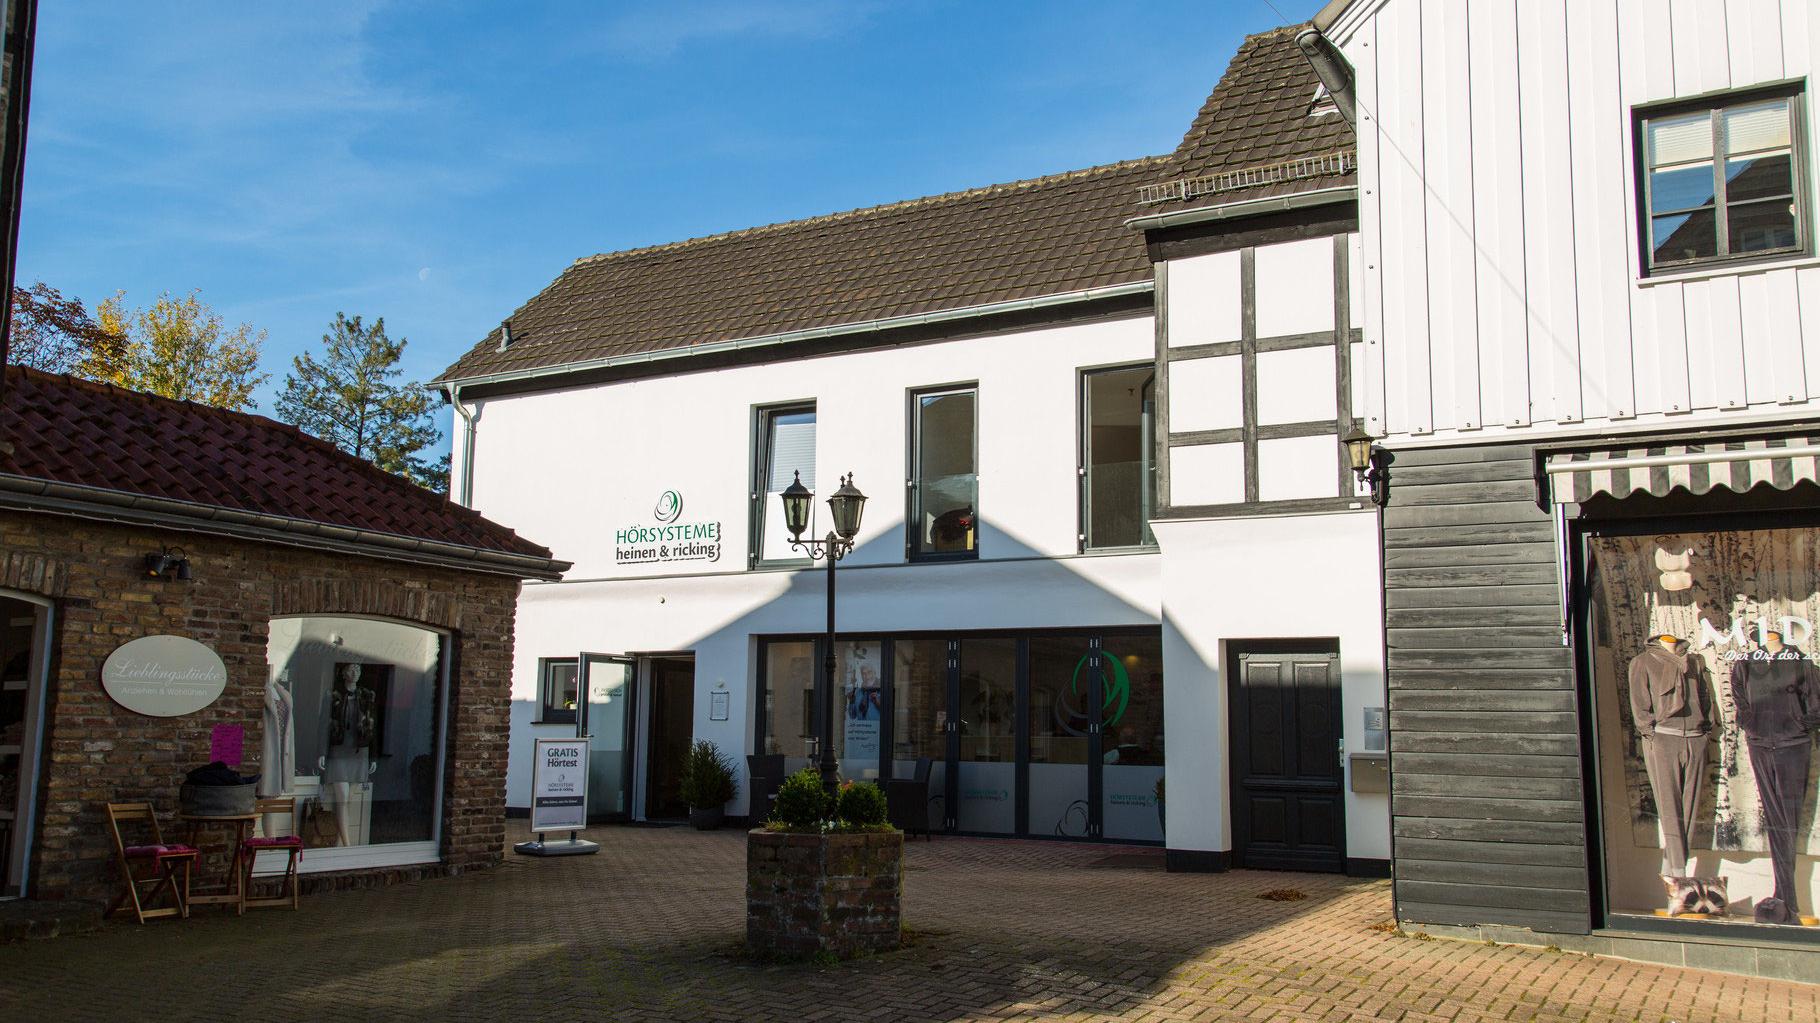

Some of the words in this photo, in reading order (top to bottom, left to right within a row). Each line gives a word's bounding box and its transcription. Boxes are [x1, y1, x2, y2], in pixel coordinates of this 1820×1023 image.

[616, 523, 716, 544] HÖRSYSTEME
[616, 546, 656, 560] heinen
[659, 545, 669, 557] &
[673, 542, 715, 558] ricking
[1725, 650, 1749, 661] Der
[1753, 649, 1775, 661] Ort
[1777, 649, 1800, 660] der
[112, 660, 221, 686] Lieblingsstücke
[547, 748, 578, 757] GRATIS
[547, 758, 578, 768] Hörtest
